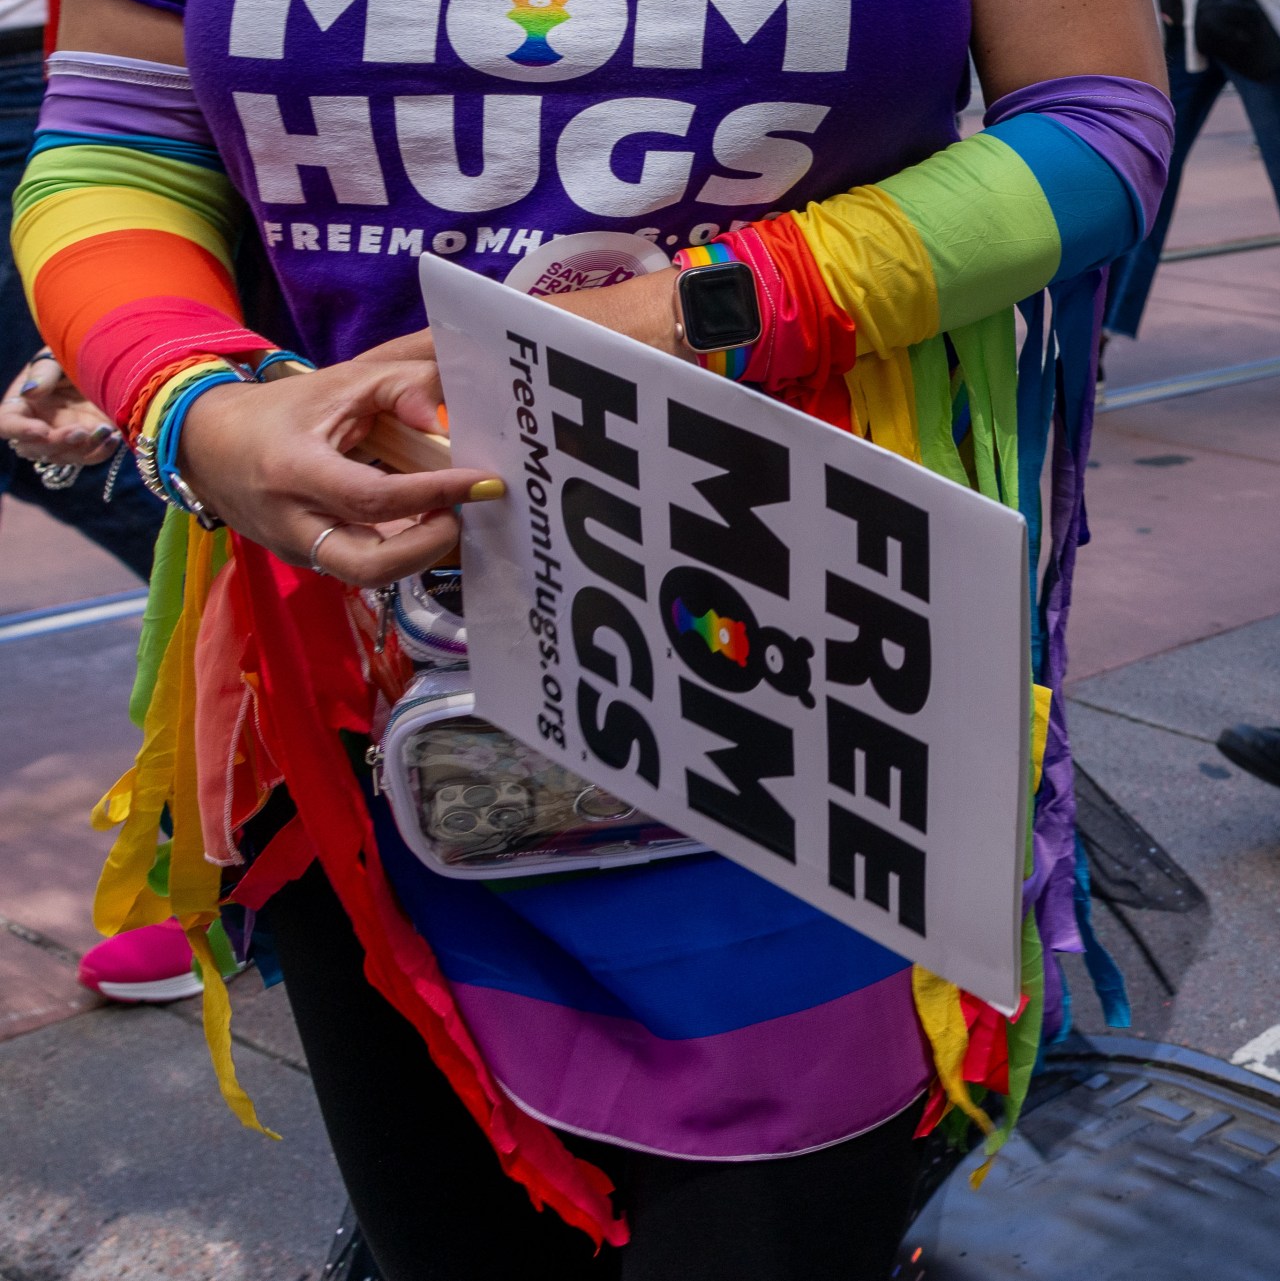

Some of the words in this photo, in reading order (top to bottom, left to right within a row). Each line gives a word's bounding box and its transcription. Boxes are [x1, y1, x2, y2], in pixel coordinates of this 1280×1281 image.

[233, 92, 832, 218] HUGS
[547, 262, 590, 286] SAN
[506, 329, 566, 751] FreeMomHugs.org
[546, 346, 661, 791] HUGS
[659, 397, 816, 865] MOM
[825, 463, 932, 938] FREE
